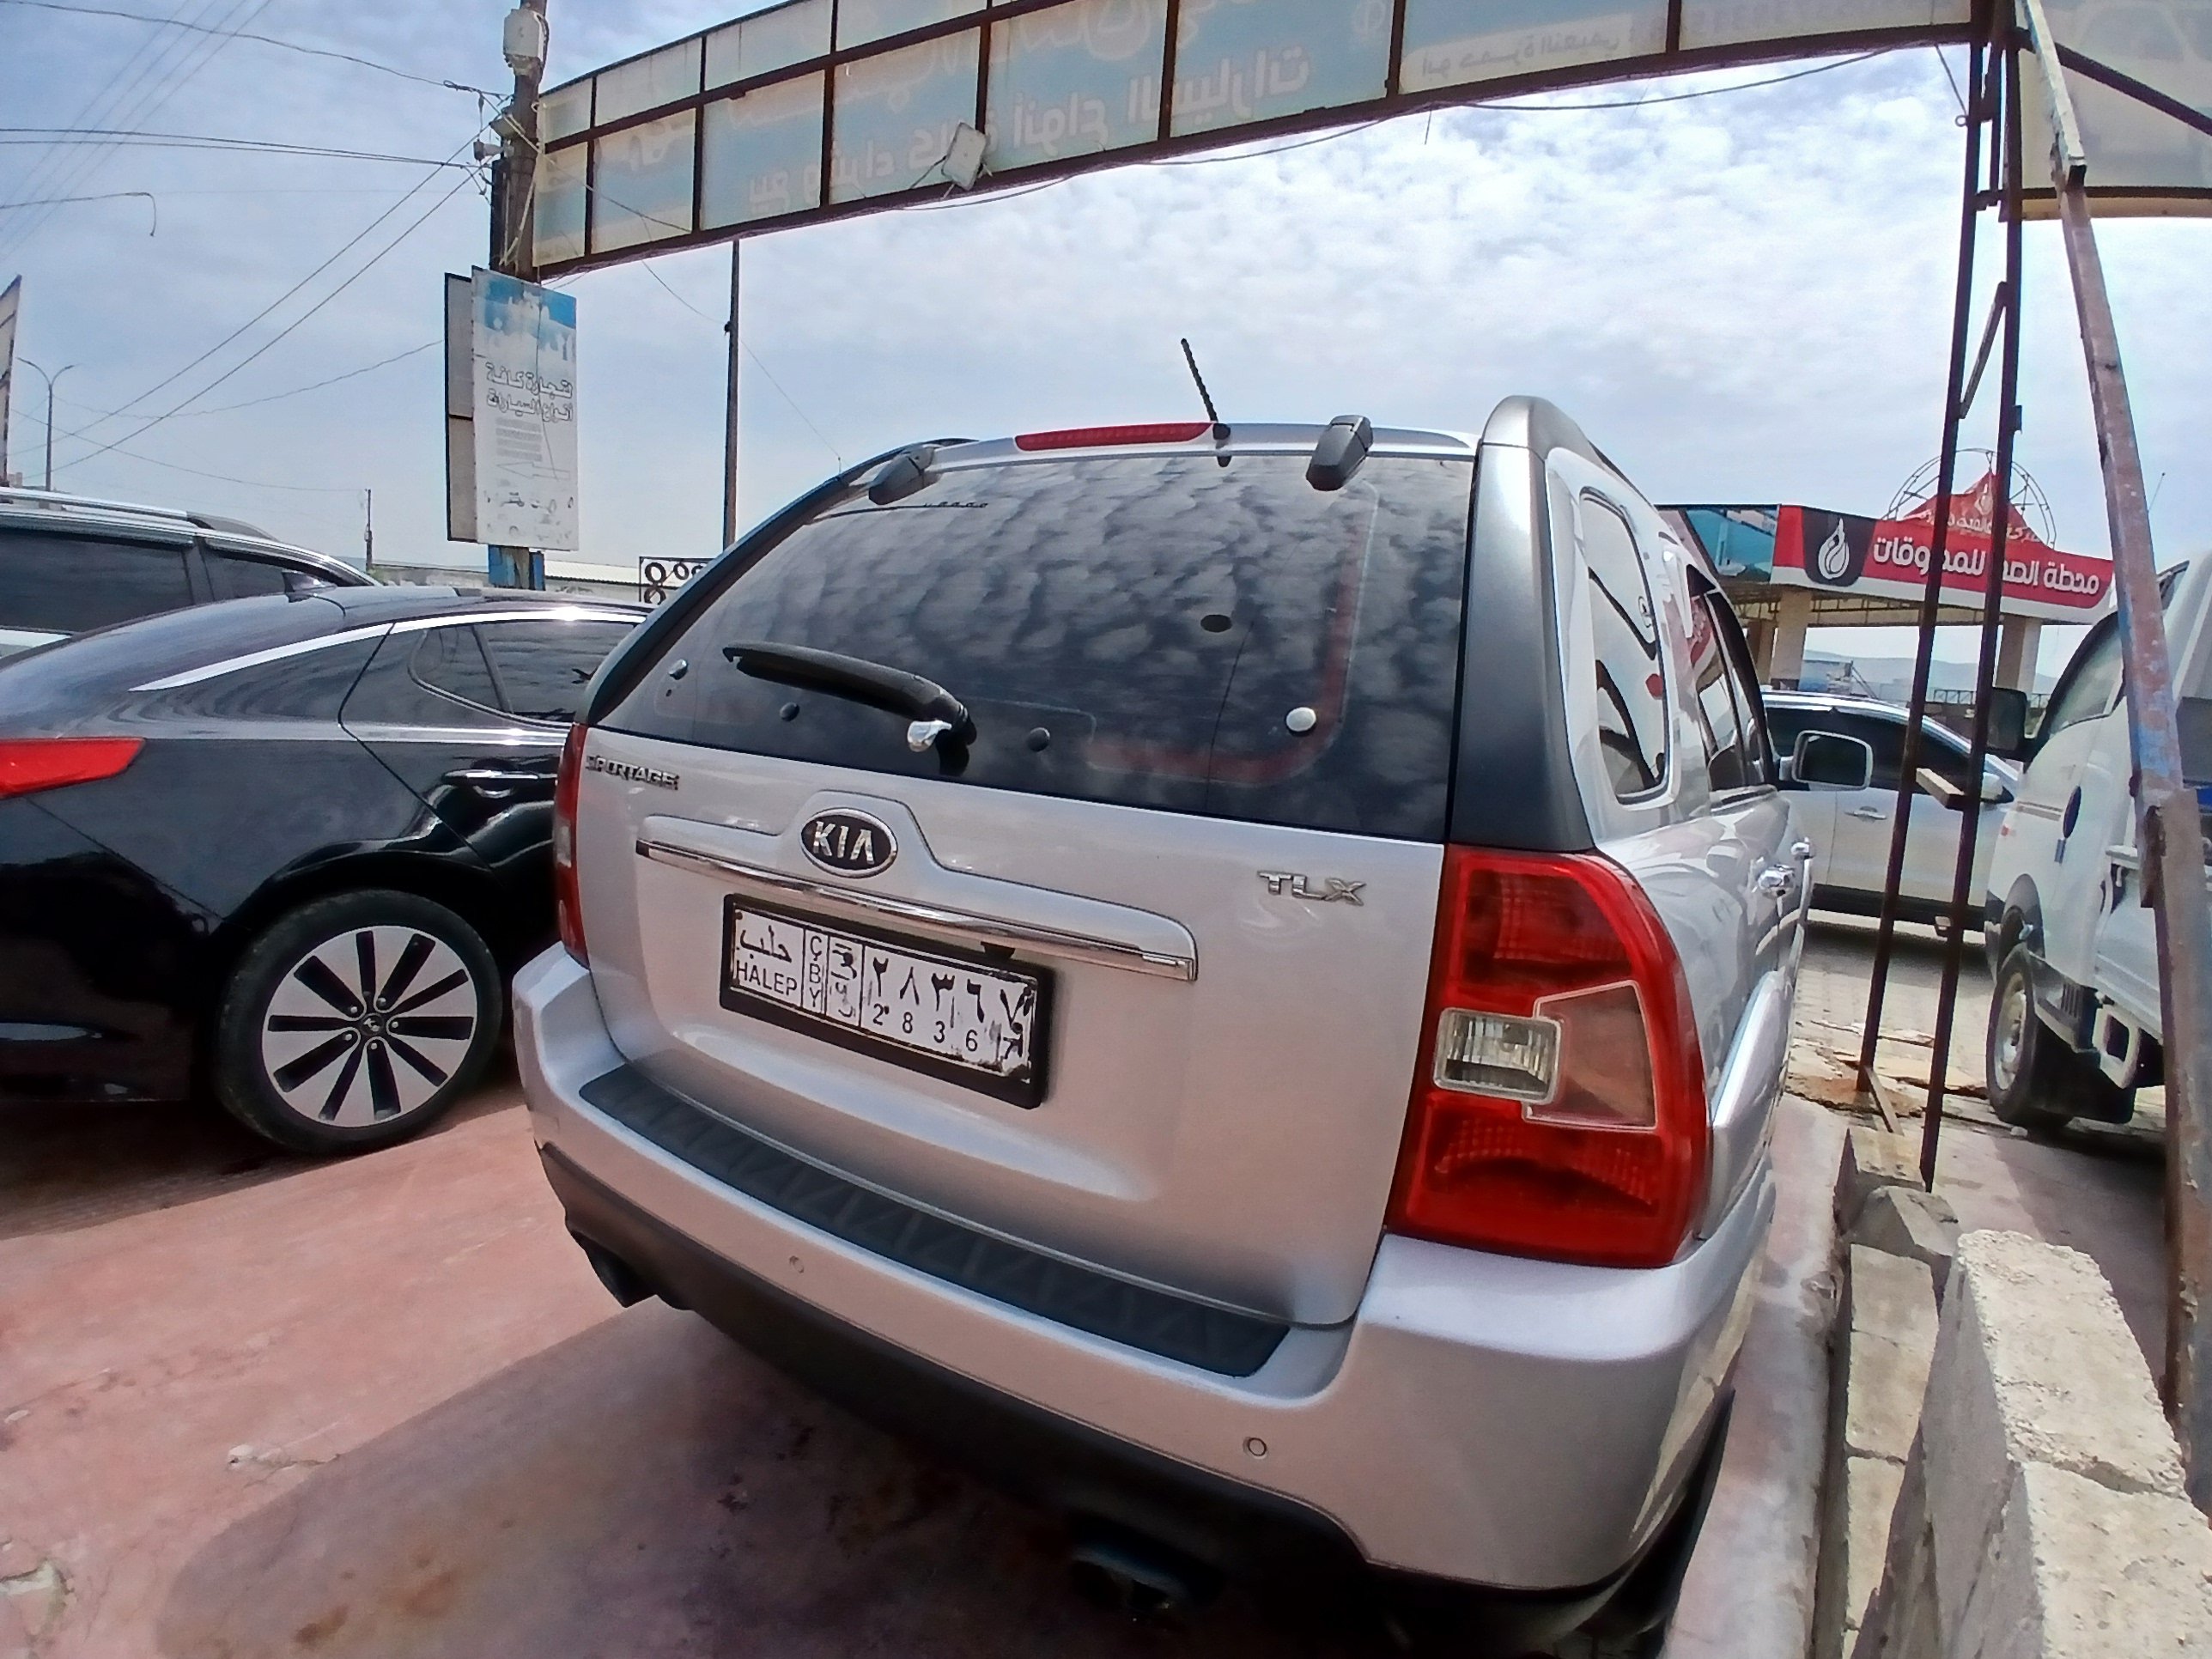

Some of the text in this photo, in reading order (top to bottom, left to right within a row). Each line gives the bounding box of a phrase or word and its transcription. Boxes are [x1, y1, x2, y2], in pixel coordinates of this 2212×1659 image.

[2043, 561, 2100, 596] محطة
[585, 754, 680, 790] SPORTAGE
[813, 821, 874, 865] KIA
[1257, 870, 1366, 907] TLX
[739, 925, 793, 963] حلب
[736, 959, 798, 996] HALEP
